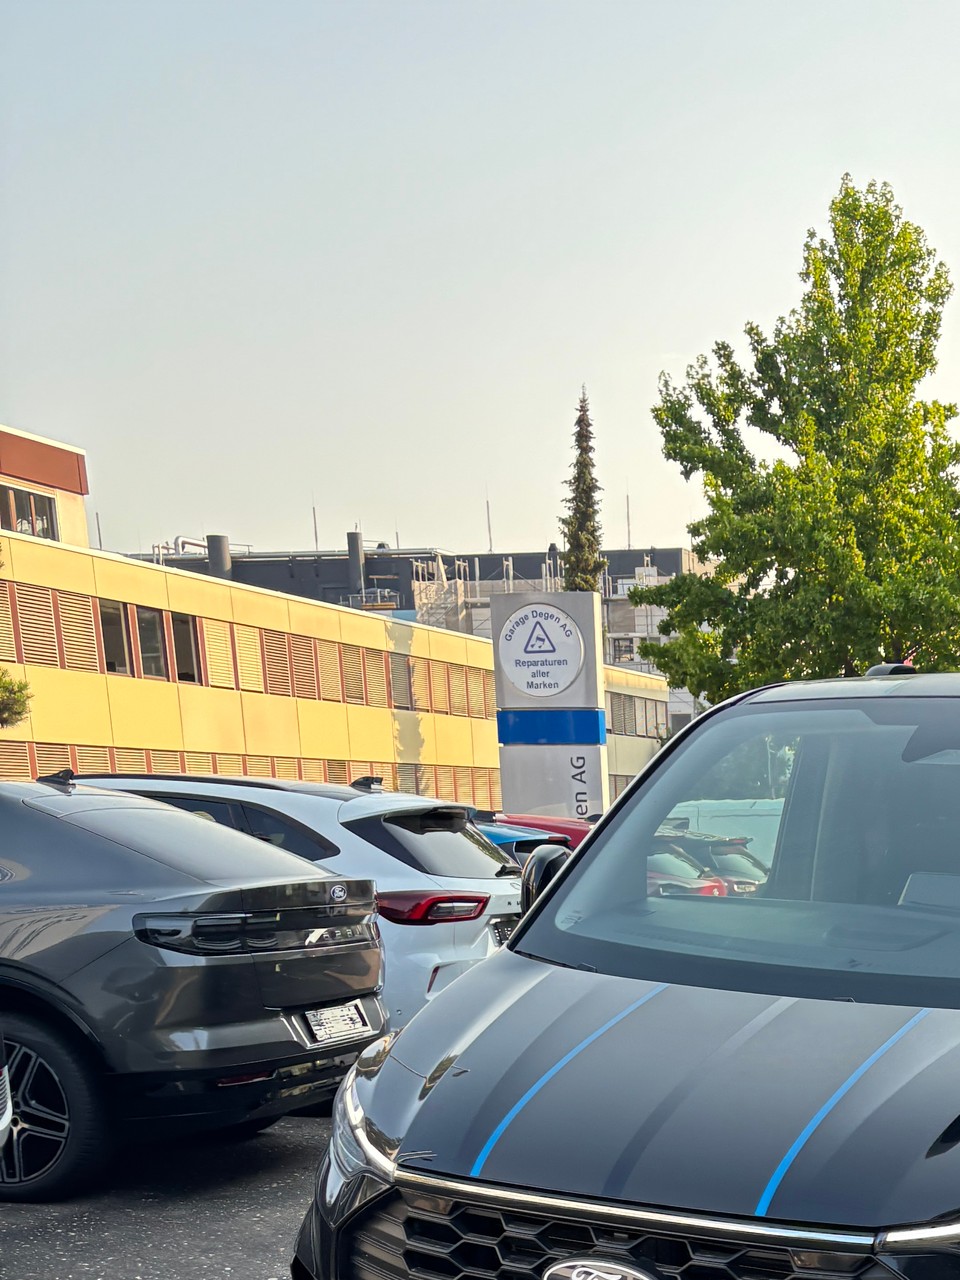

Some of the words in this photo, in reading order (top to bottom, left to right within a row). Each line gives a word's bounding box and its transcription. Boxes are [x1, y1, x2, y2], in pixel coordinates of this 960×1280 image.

[504, 614, 529, 641] Garage
[531, 610, 561, 624] Degen
[560, 623, 573, 638] AG
[514, 658, 568, 669] Reparaturen
[531, 669, 550, 678] aller
[526, 680, 559, 689] Marken
[570, 756, 587, 784] AG
[575, 792, 588, 820] en
